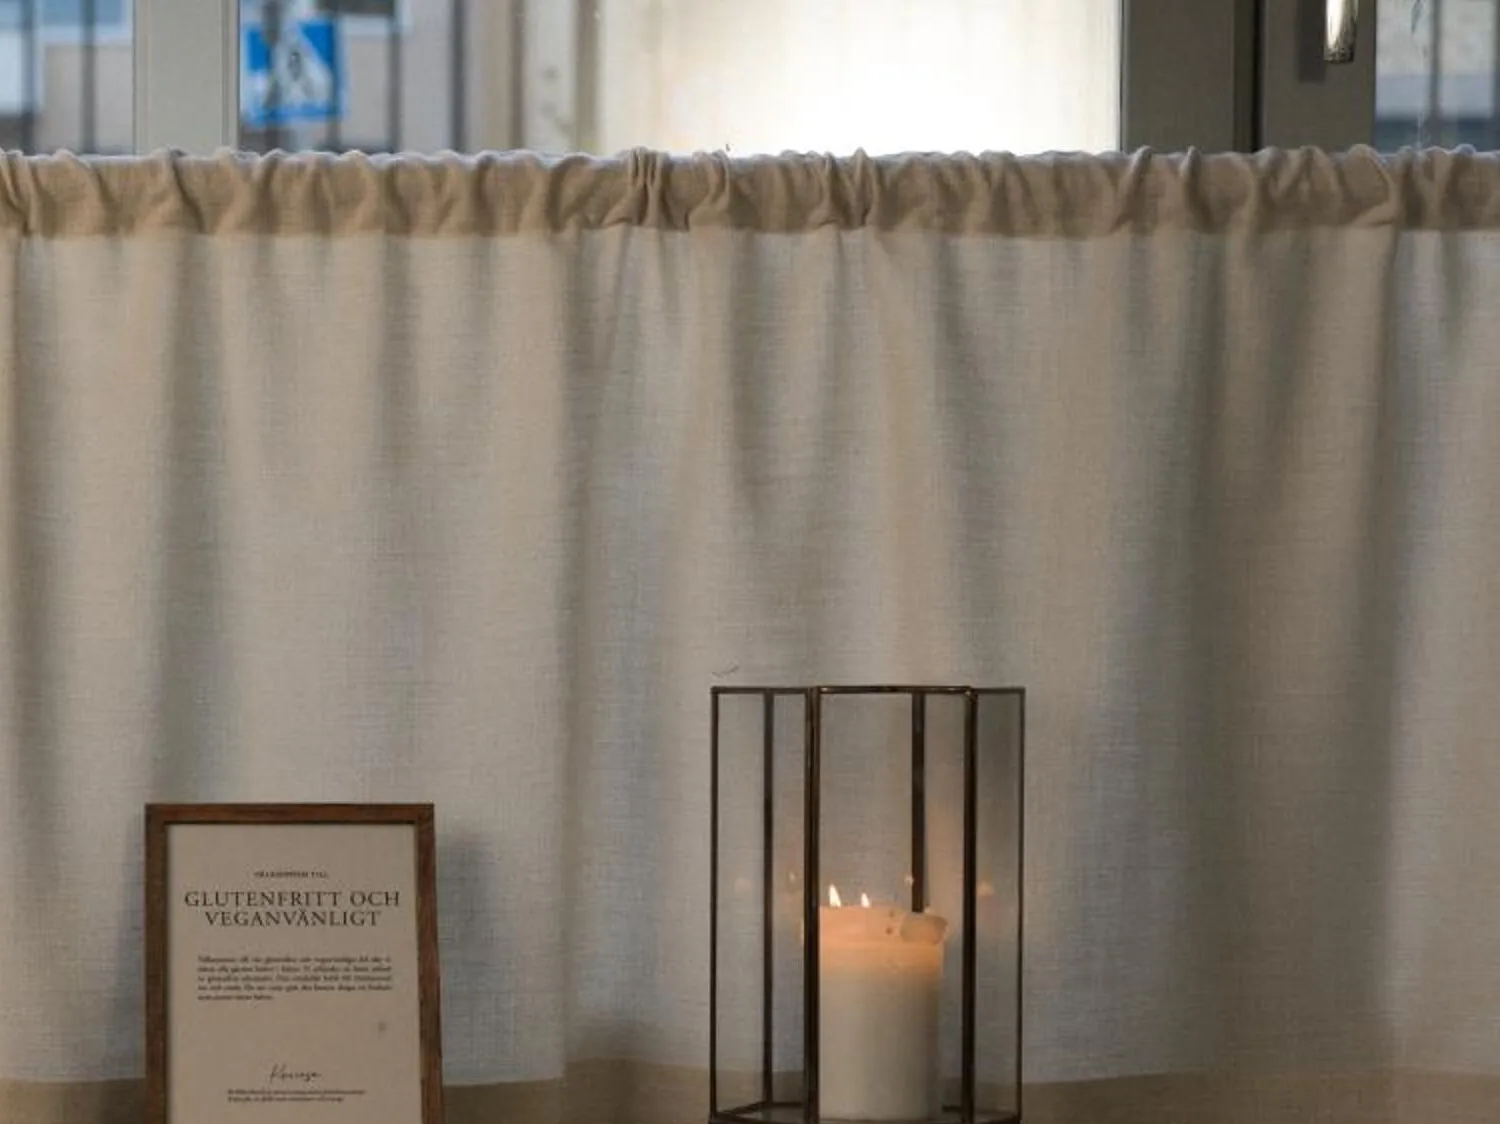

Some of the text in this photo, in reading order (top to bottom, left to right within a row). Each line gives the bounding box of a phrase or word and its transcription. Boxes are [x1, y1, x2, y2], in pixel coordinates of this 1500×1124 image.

[184, 891, 399, 907] GLUTENFRITT OCH
[204, 908, 381, 926] VEGANVÄNLIGT
